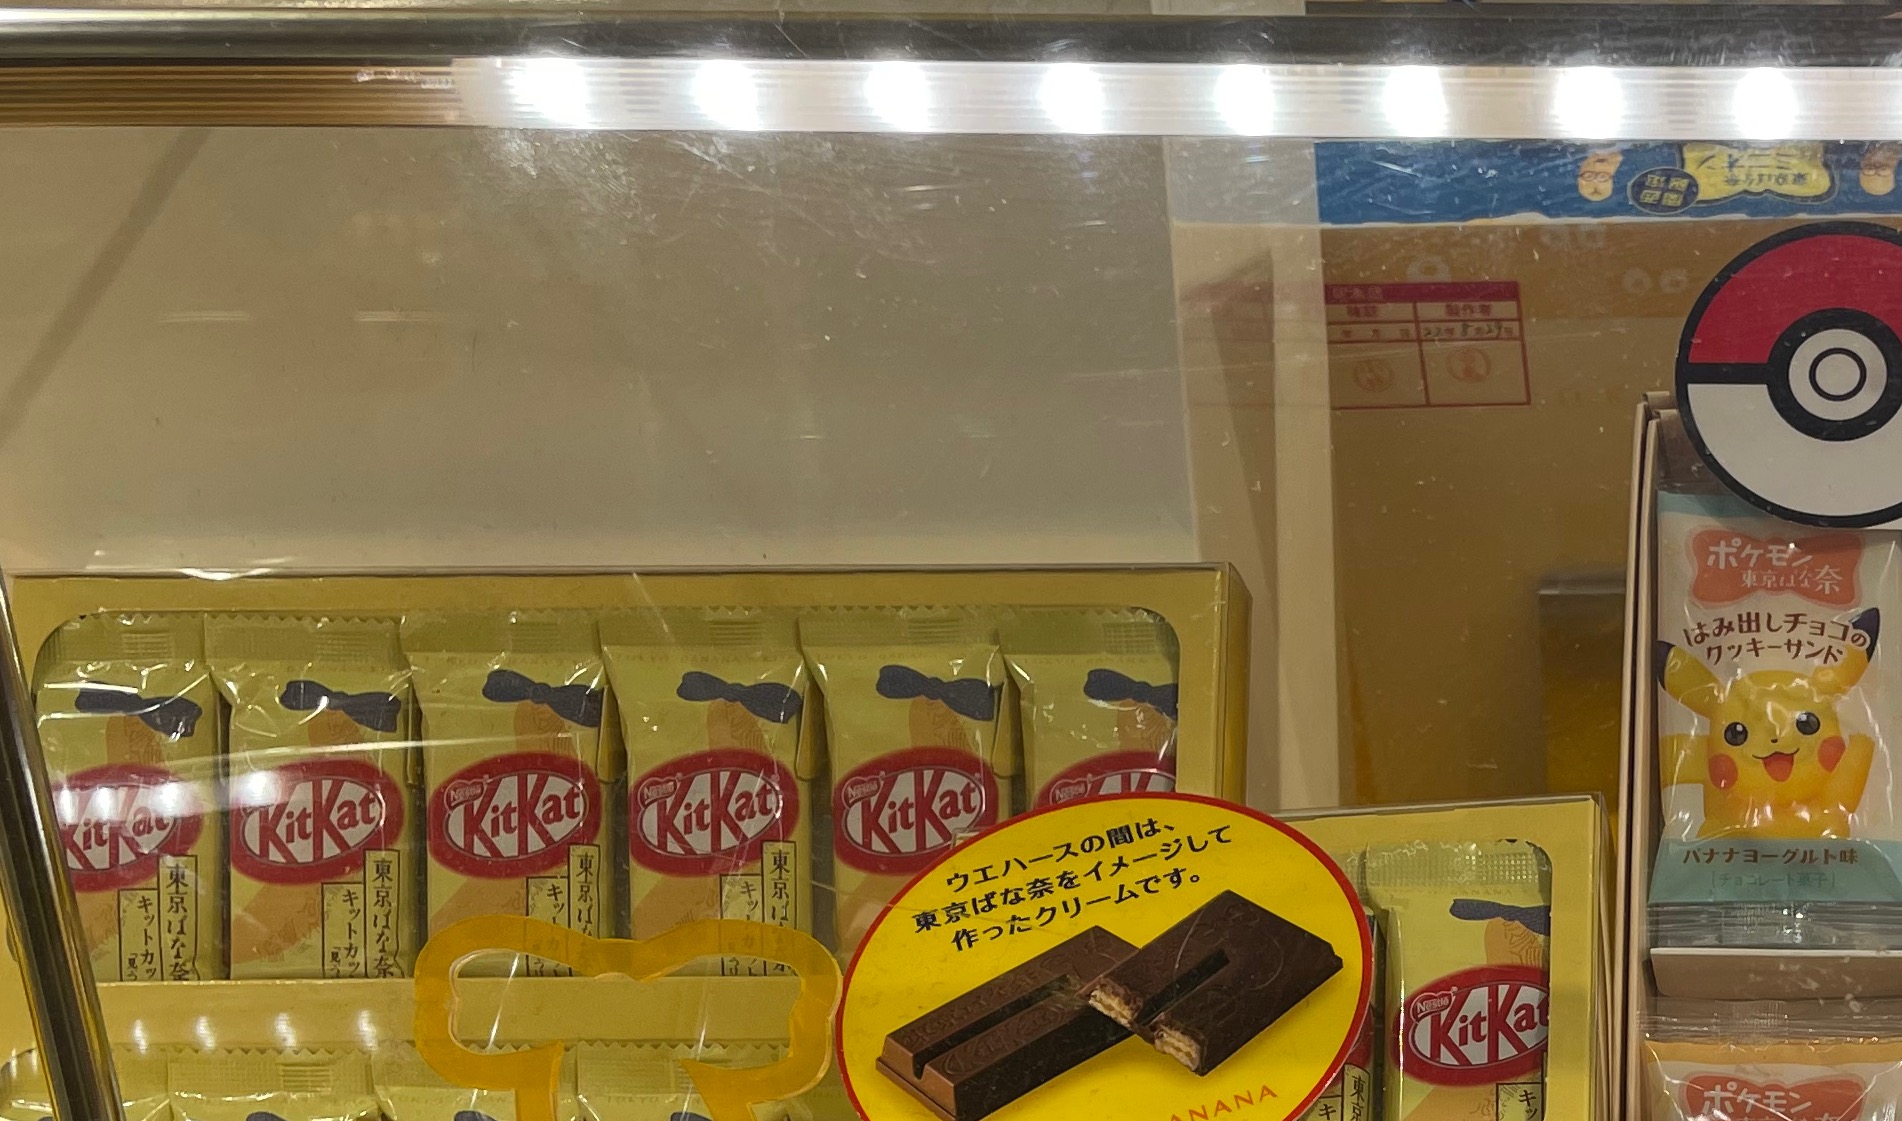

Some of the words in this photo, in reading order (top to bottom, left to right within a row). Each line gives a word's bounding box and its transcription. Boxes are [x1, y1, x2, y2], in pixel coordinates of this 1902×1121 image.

[1683, 611, 1870, 648] はみ出しチョコの
[1707, 639, 1844, 665] クッキーサンド
[258, 774, 384, 865] KitKat
[458, 771, 583, 861] KitKat
[657, 769, 775, 855] KitKat
[861, 766, 980, 854] KitKat
[912, 825, 1233, 934] 東京ばな奈をイメージして
[945, 818, 1175, 893] ウエハースの間は、
[1683, 847, 1858, 865] バナナヨーグルト味
[951, 867, 1201, 952] 作ったクリームです。
[1703, 1081, 1812, 1117] ポケモン
